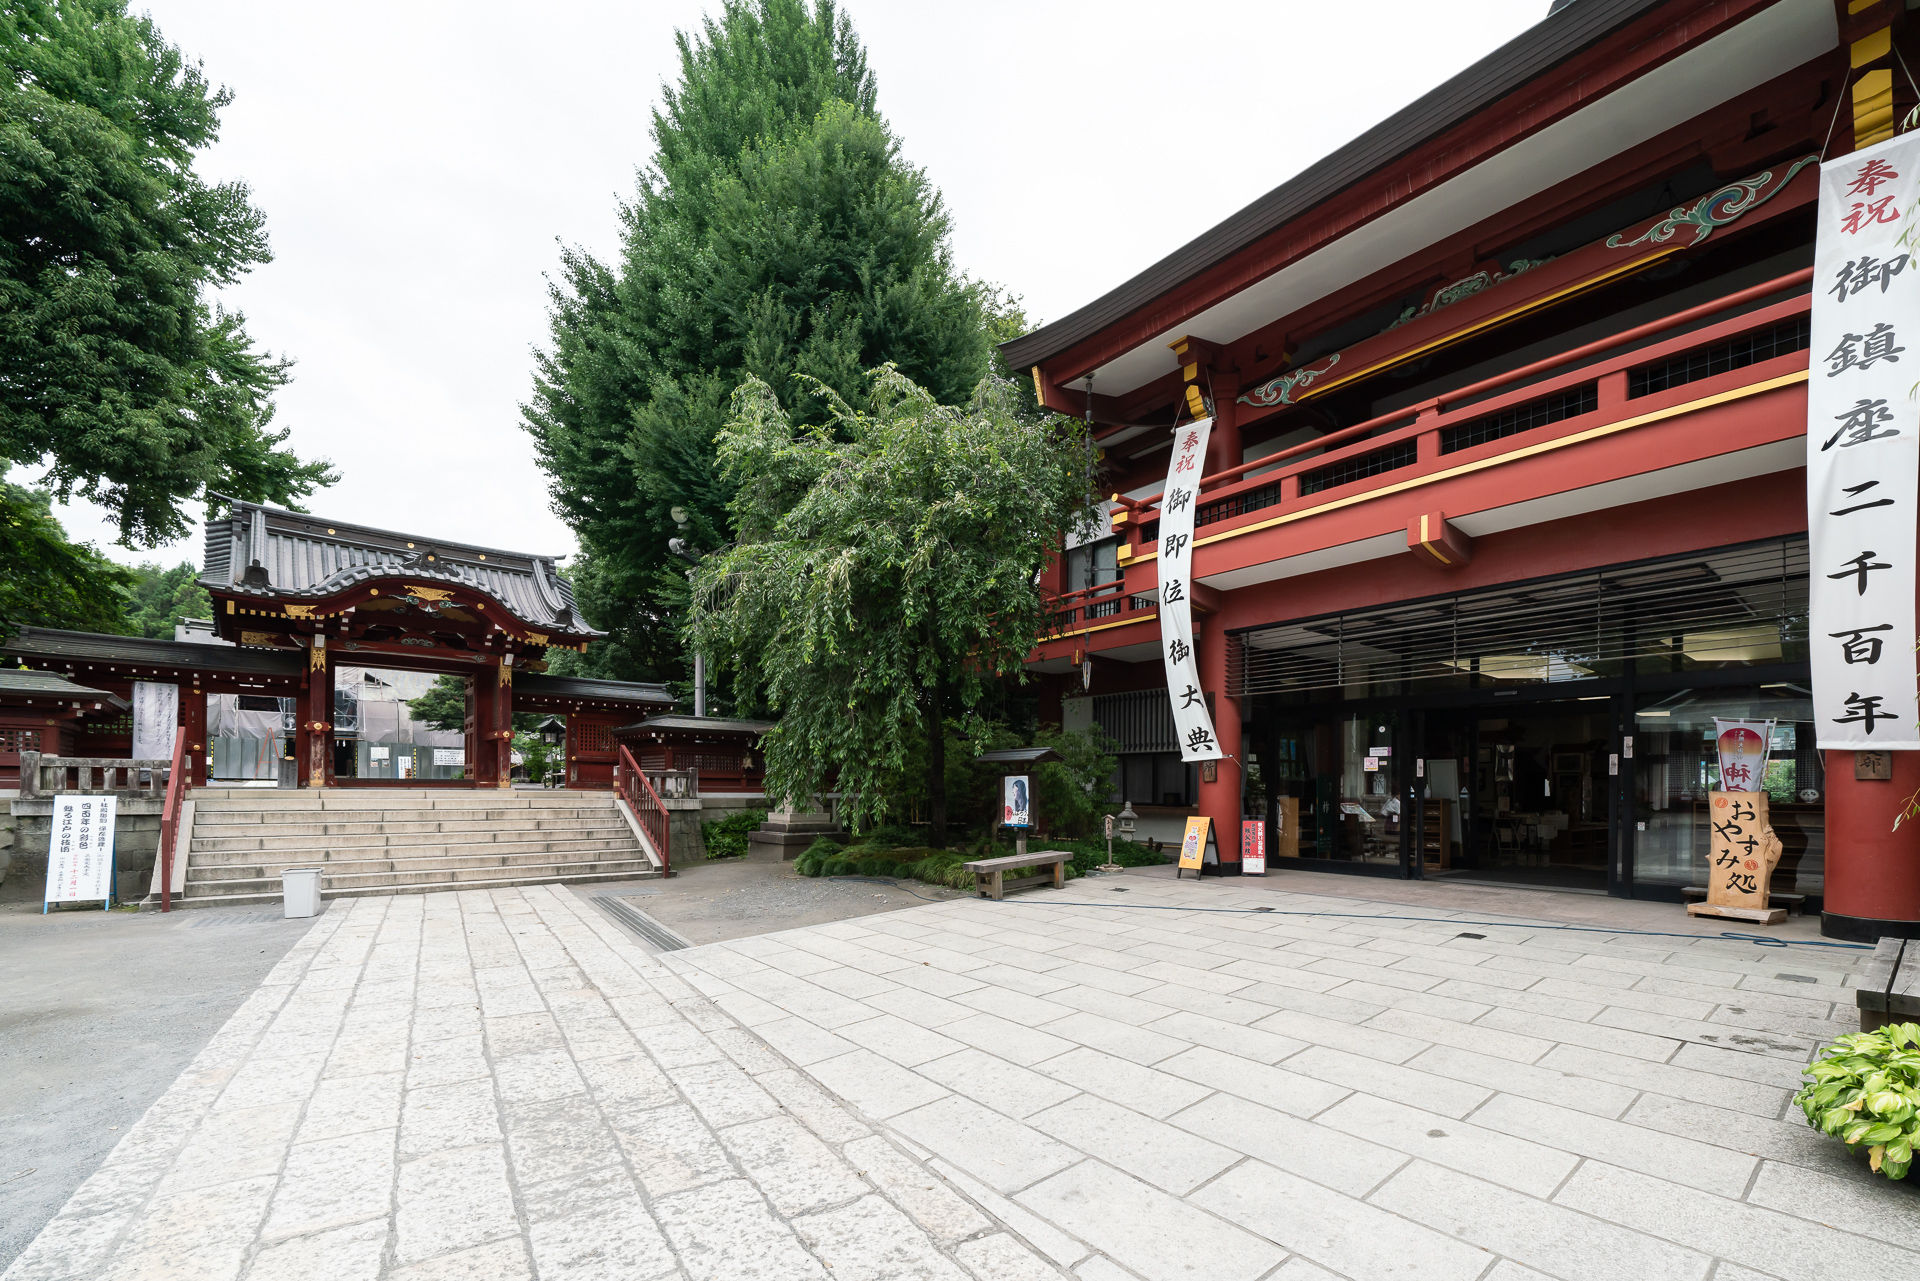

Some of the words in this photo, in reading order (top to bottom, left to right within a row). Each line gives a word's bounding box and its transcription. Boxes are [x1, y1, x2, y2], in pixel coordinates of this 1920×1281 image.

[1841, 159, 1900, 234] 奉祝
[1175, 431, 1199, 474] 奉祝
[1821, 254, 1909, 735] 御鎮座二千百年
[1163, 487, 1214, 752] 御即位御大典
[1713, 801, 1759, 894] おやすみ処
